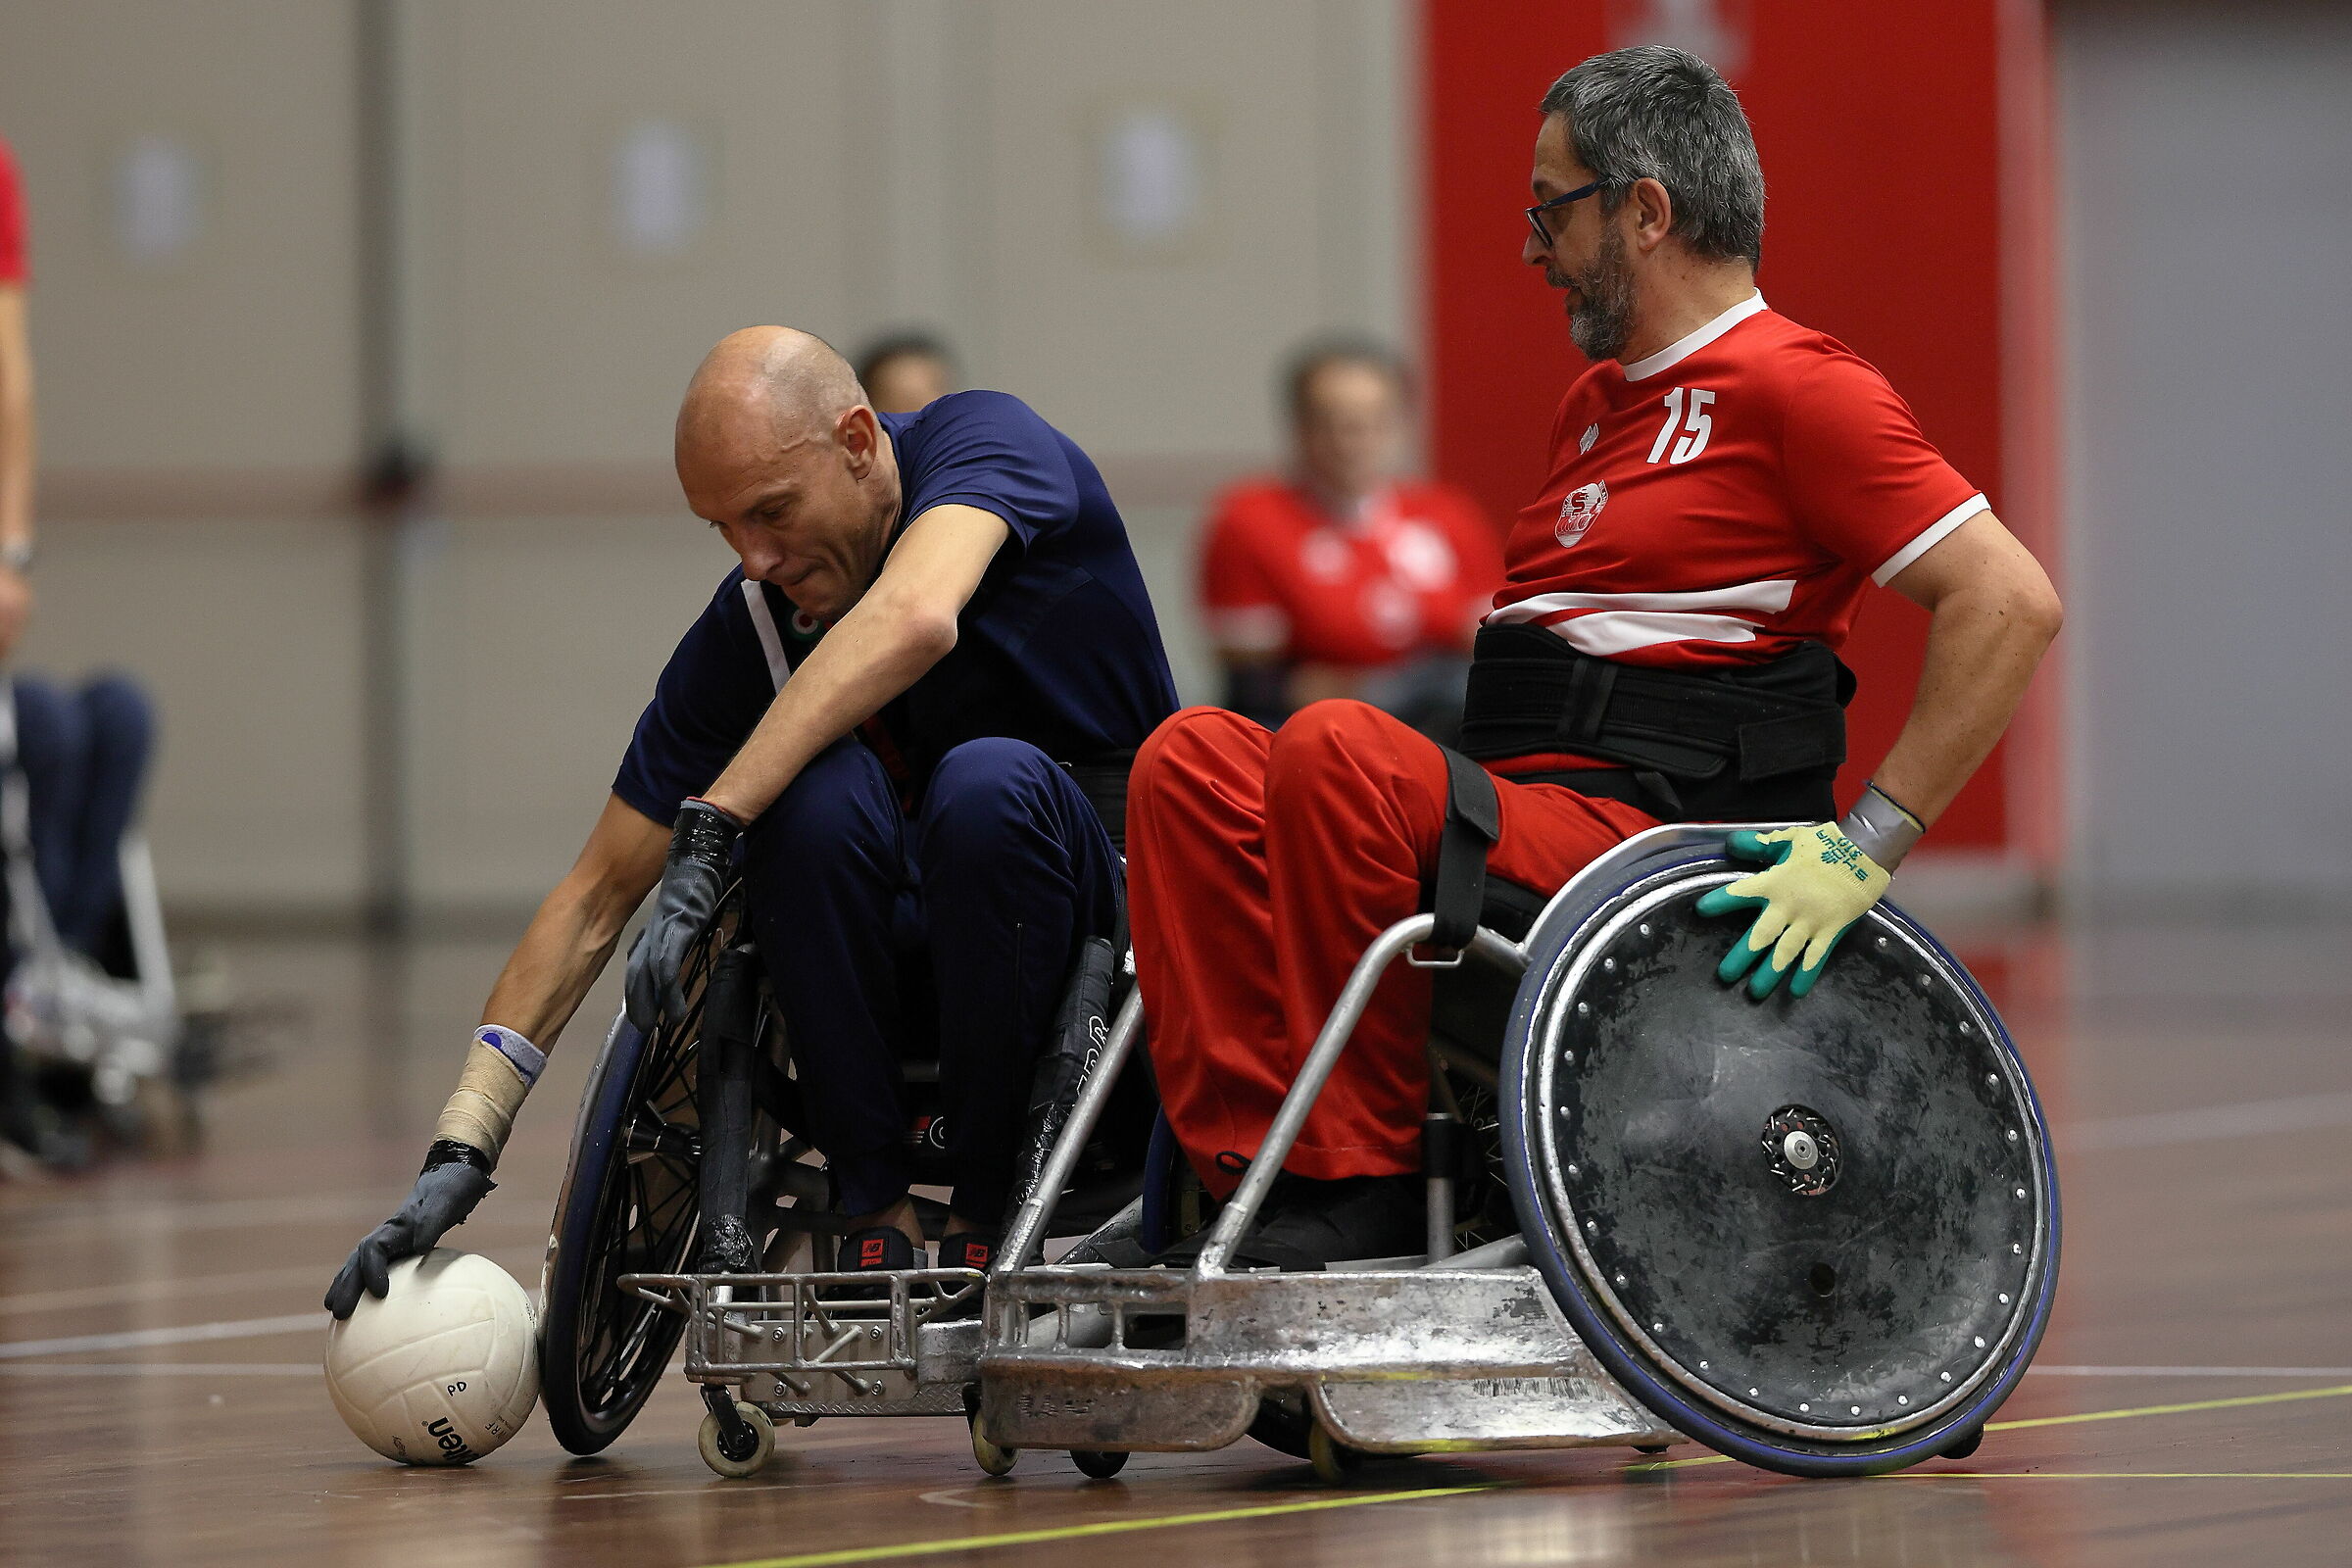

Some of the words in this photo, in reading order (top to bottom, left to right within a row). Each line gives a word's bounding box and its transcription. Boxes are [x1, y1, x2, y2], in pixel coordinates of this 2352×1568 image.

[1646, 386, 1715, 465] 15
[1815, 829, 1869, 882] SHOWA
[1837, 836, 1862, 860] 310
[447, 1381, 467, 1396] PD
